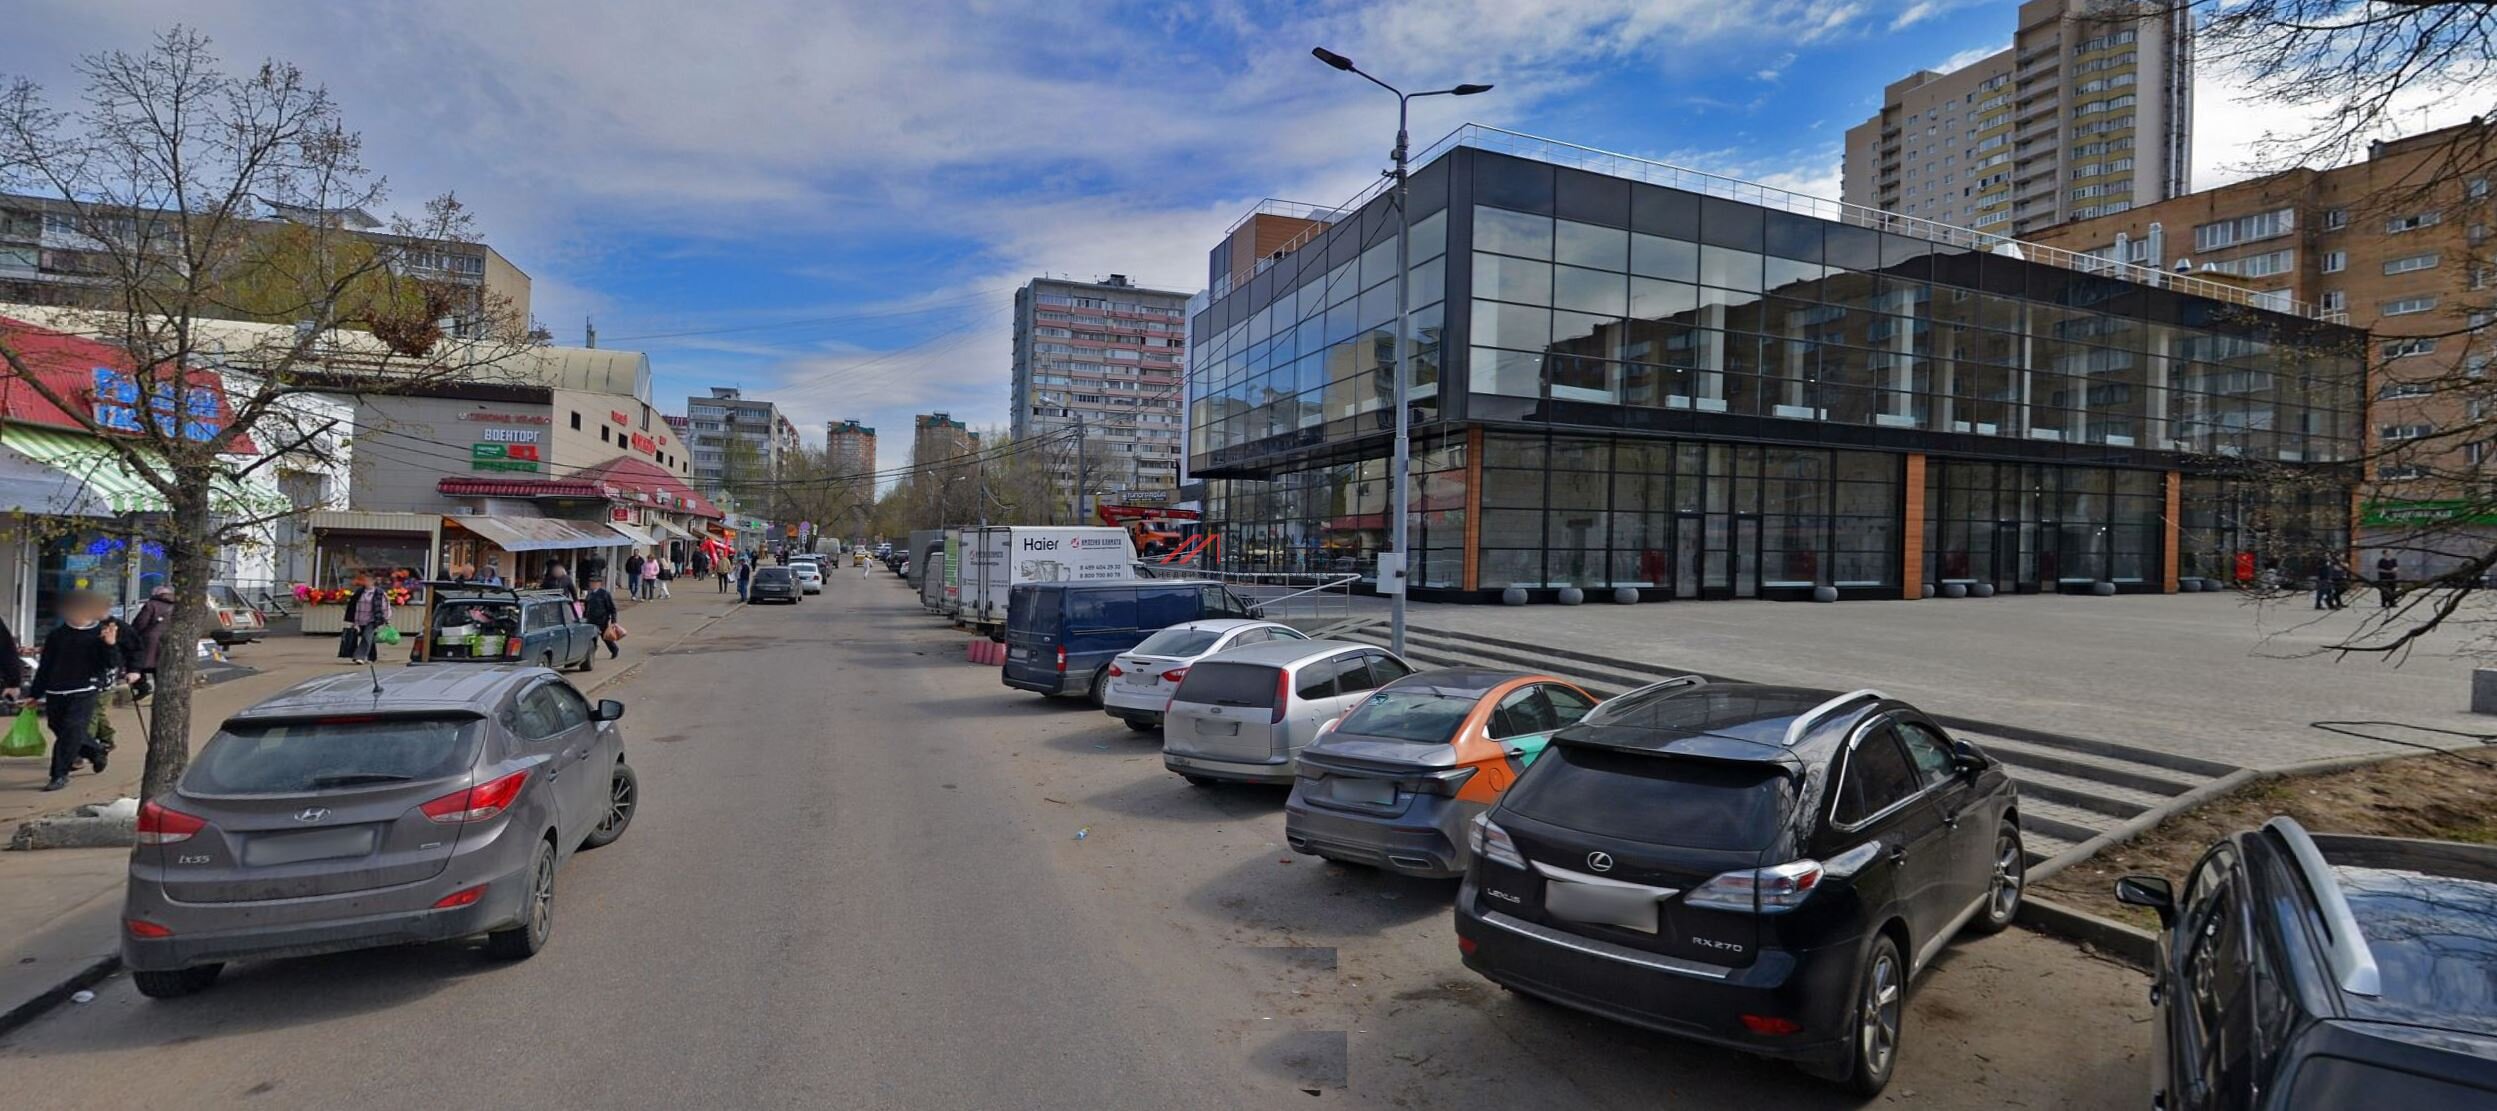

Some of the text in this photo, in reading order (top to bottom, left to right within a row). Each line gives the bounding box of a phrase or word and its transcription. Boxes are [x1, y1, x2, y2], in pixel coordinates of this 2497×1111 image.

[484, 429, 540, 442] ВОЕНТОРГ
[1023, 537, 1059, 551] Haier
[1487, 887, 1521, 904] LEXUS
